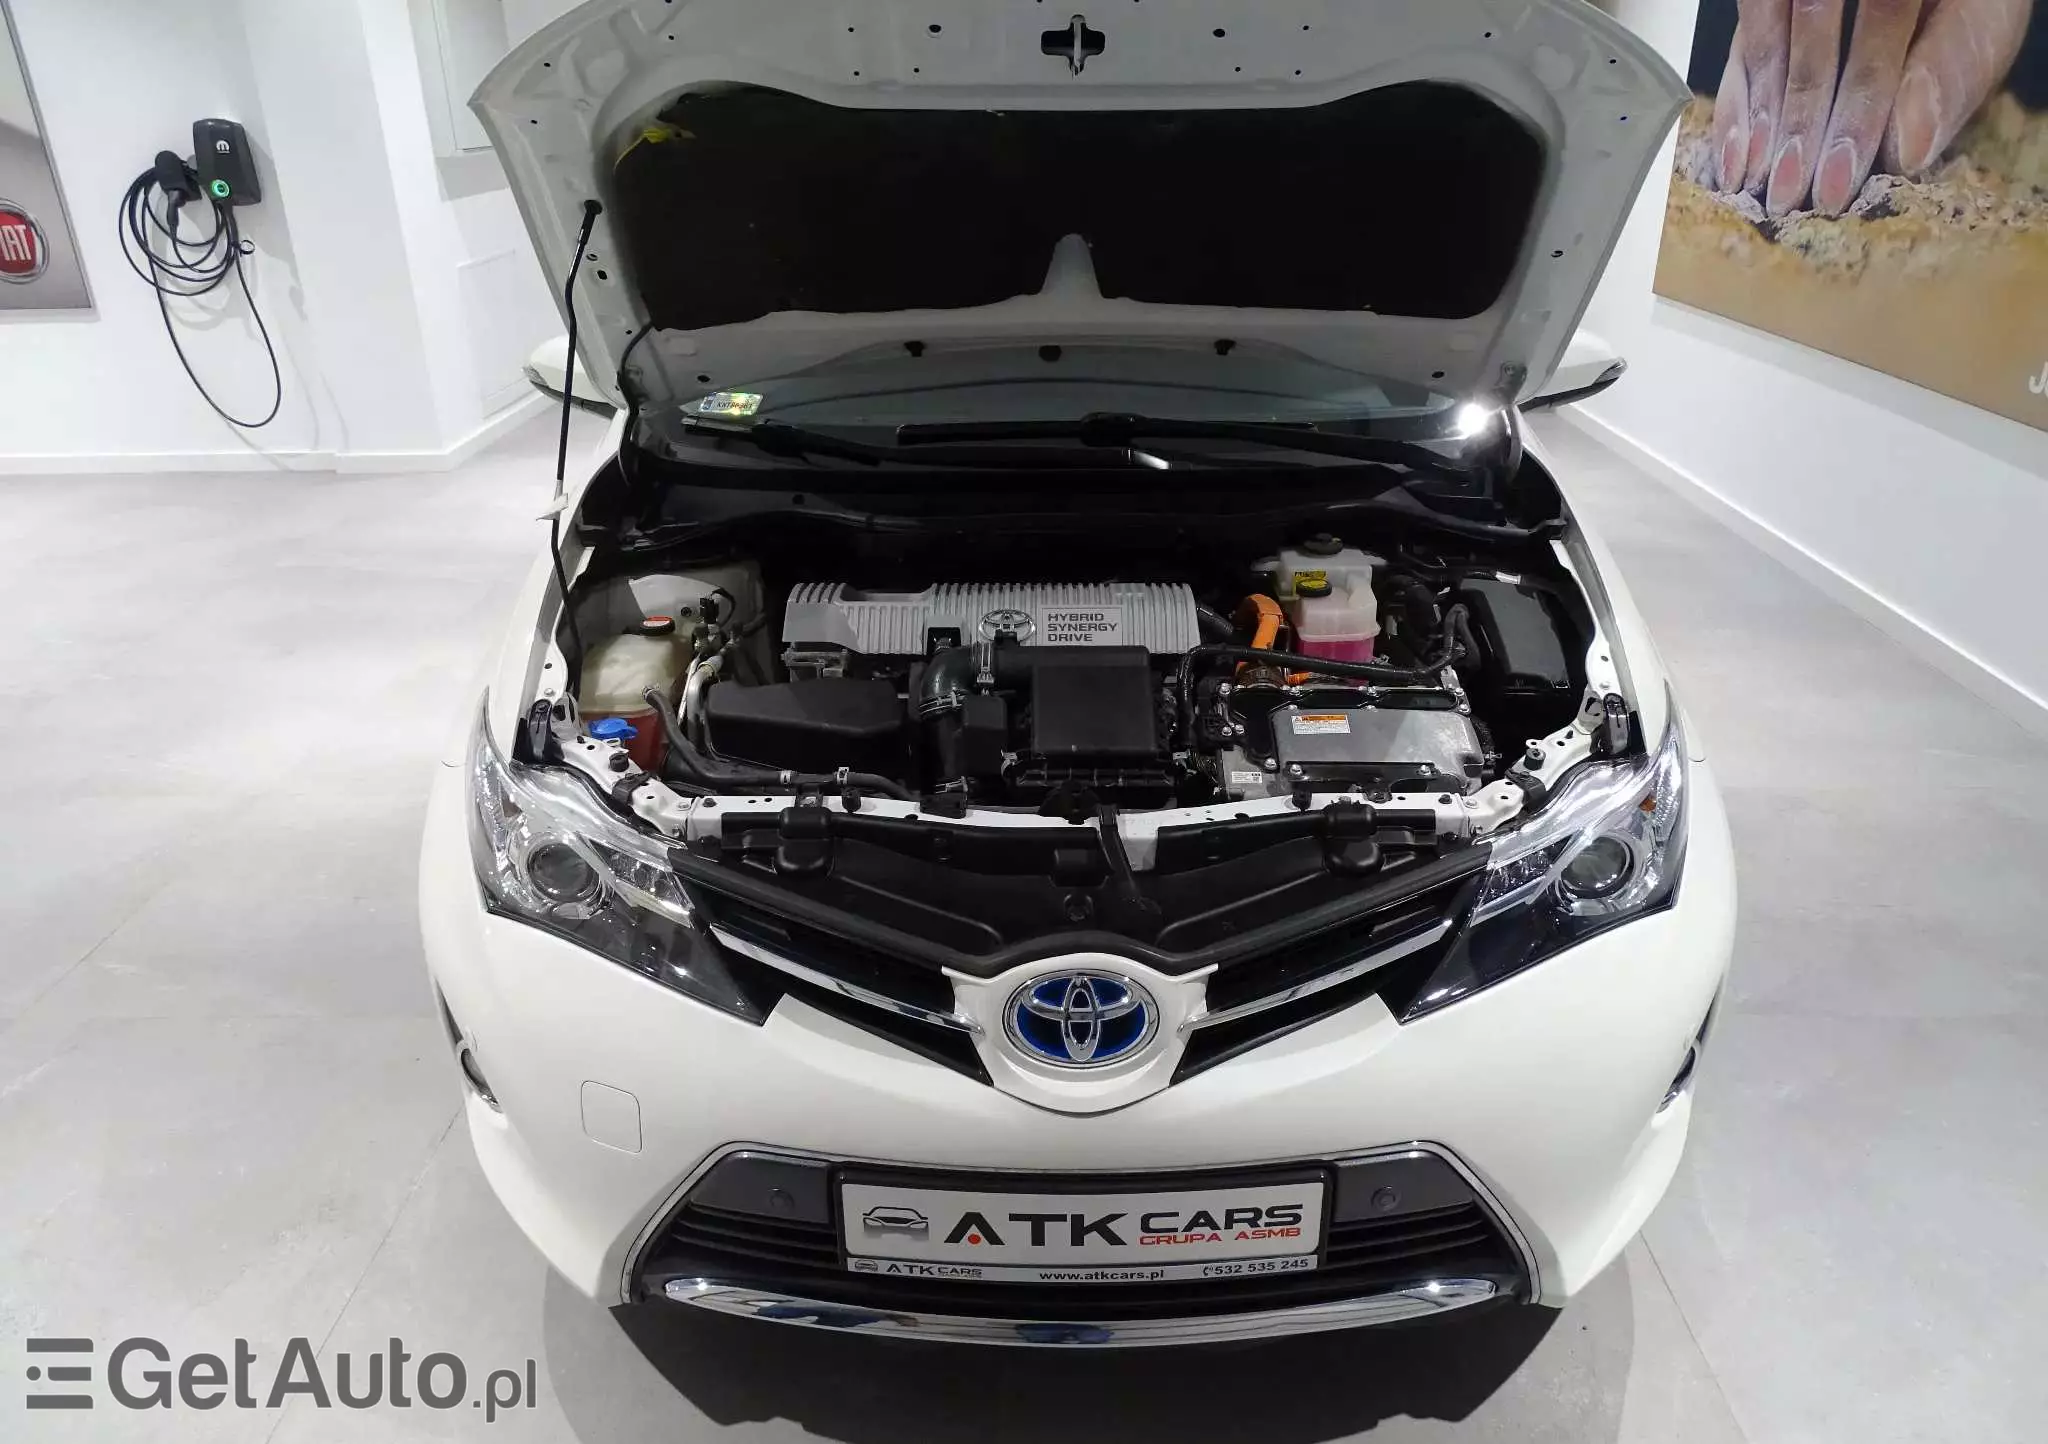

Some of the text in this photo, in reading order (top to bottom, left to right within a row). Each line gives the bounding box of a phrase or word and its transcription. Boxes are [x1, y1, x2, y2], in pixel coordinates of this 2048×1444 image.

[1047, 613, 1104, 622] HYBRID
[1047, 623, 1118, 632] SYNERGY
[1047, 633, 1093, 642] DRIVE
[943, 1204, 1303, 1247] ATK CARS
[1139, 1227, 1301, 1246] GRUPA ASMB
[886, 1263, 982, 1275] ATK CARS
[1215, 1259, 1308, 1275] 532 535 245
[1039, 1269, 1165, 1280] www.atkcars.pl
